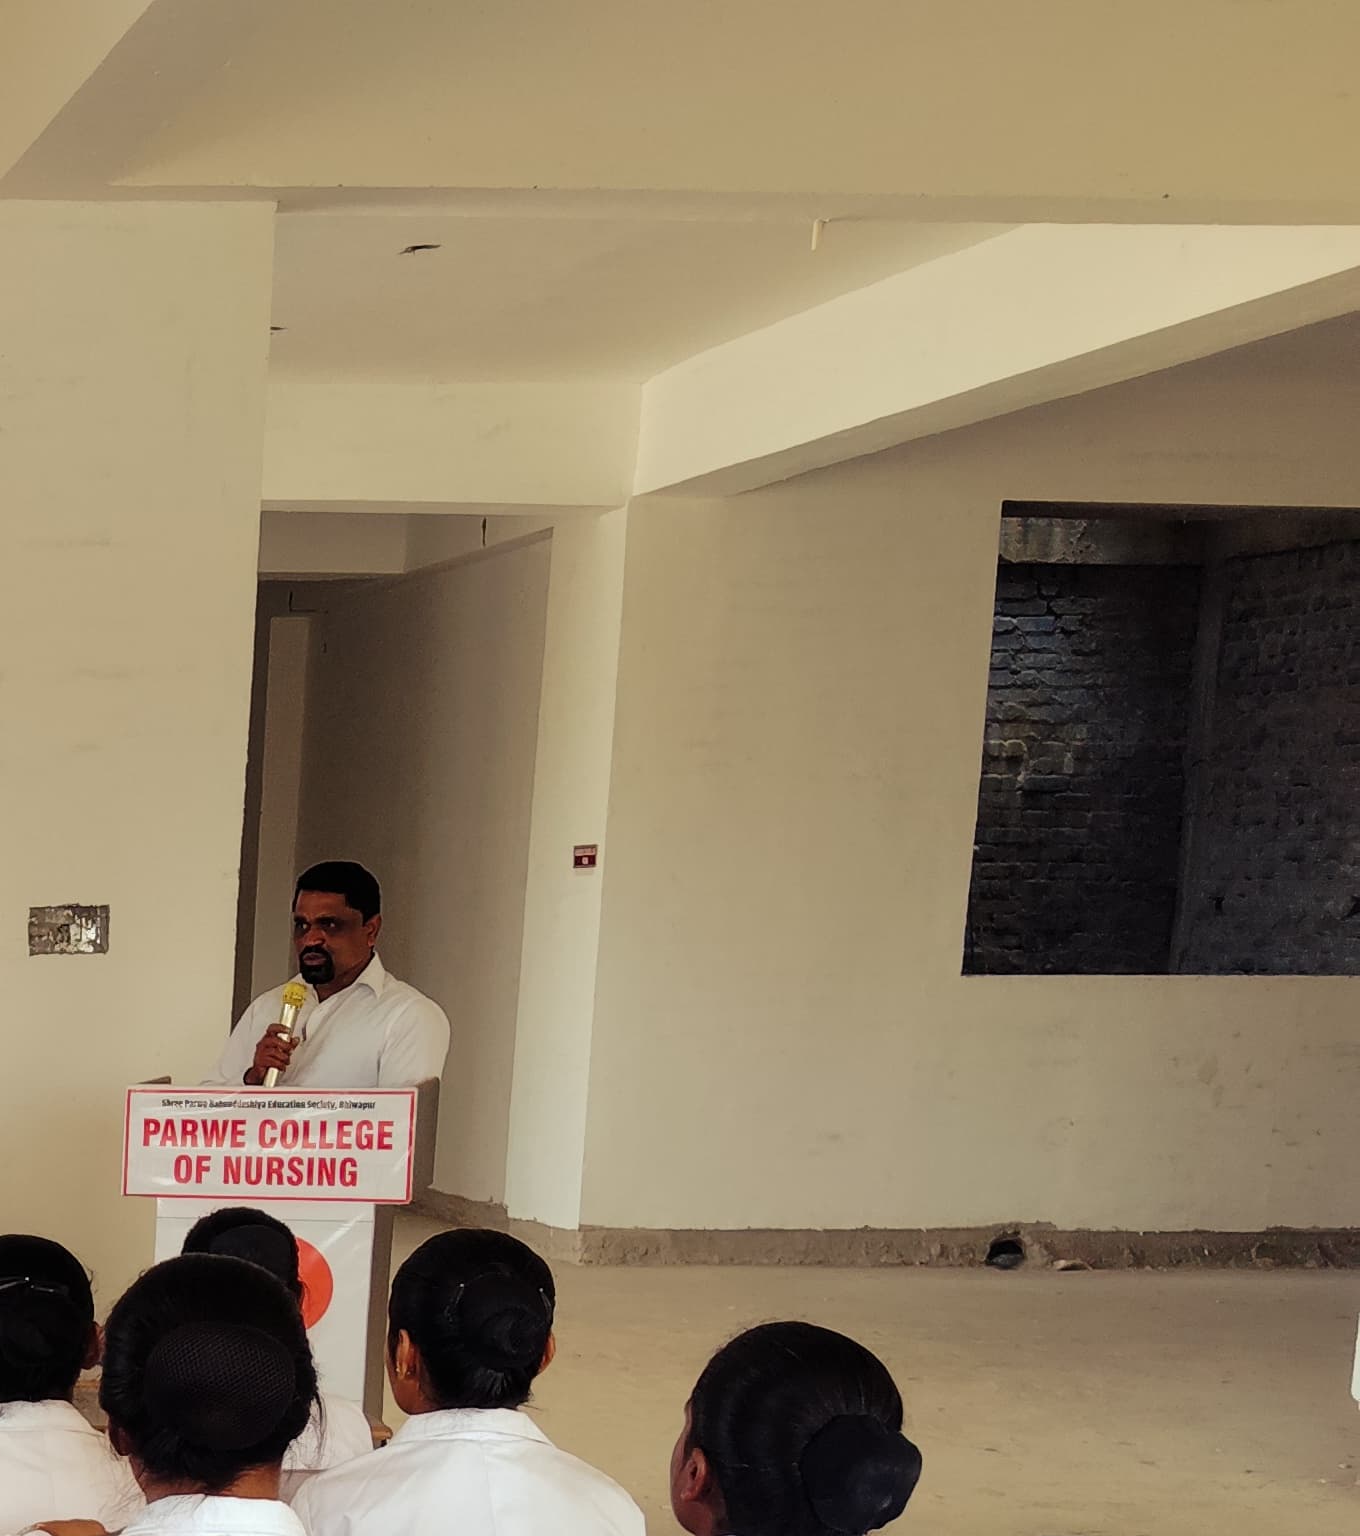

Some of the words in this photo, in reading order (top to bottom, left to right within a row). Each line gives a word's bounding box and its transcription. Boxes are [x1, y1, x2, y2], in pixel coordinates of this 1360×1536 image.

[142, 1118, 246, 1148] PARWE
[258, 1119, 394, 1150] COLLEGE
[174, 1155, 211, 1184] OF
[223, 1156, 358, 1187] NURSING
